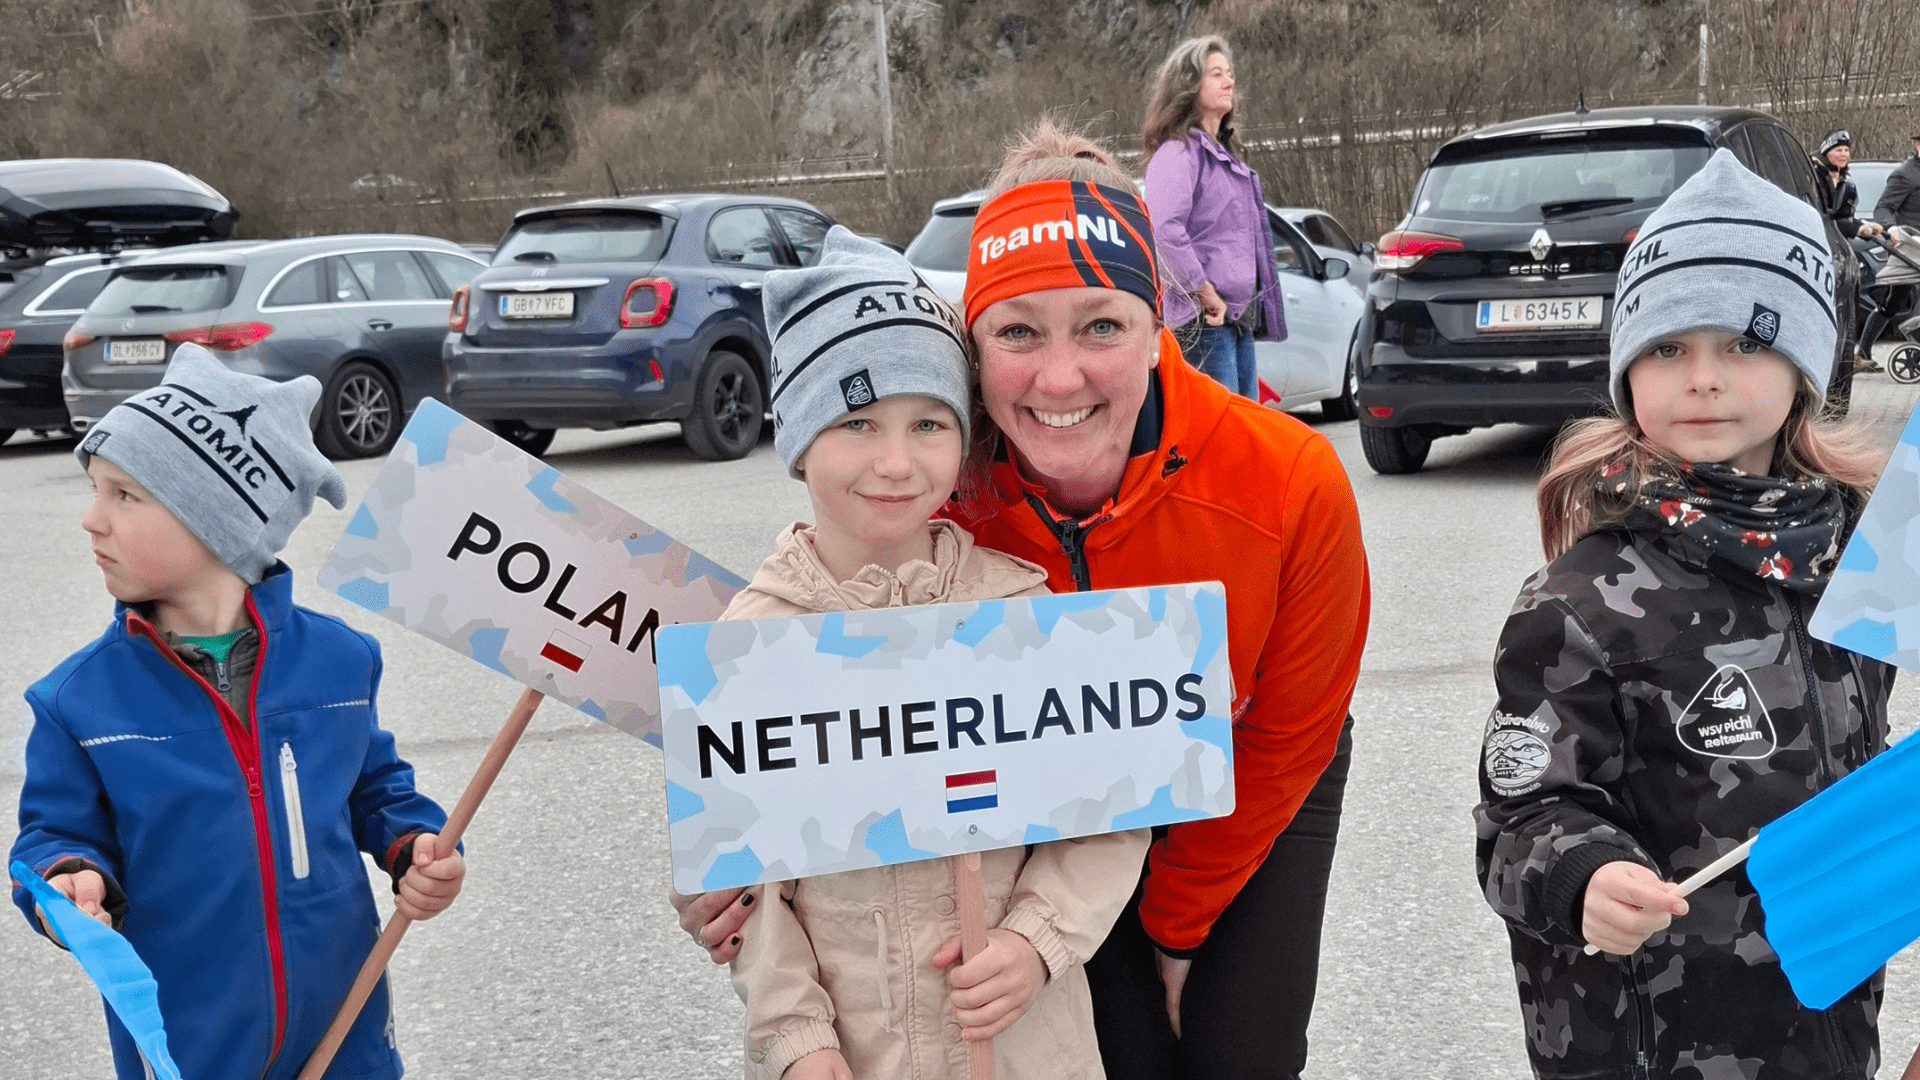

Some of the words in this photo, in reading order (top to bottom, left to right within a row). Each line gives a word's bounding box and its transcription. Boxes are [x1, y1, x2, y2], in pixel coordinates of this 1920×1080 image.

[978, 214, 1126, 265] TeamNL
[1508, 263, 1571, 275] SCENIC
[1618, 240, 1670, 291] ICHL
[1785, 245, 1834, 298] ATO
[854, 291, 959, 334] ATOM
[145, 392, 267, 490] ATOMIC
[446, 510, 659, 666] POLAN
[696, 673, 1208, 780] NETHERLANDS
[1698, 723, 1723, 737] WSV
